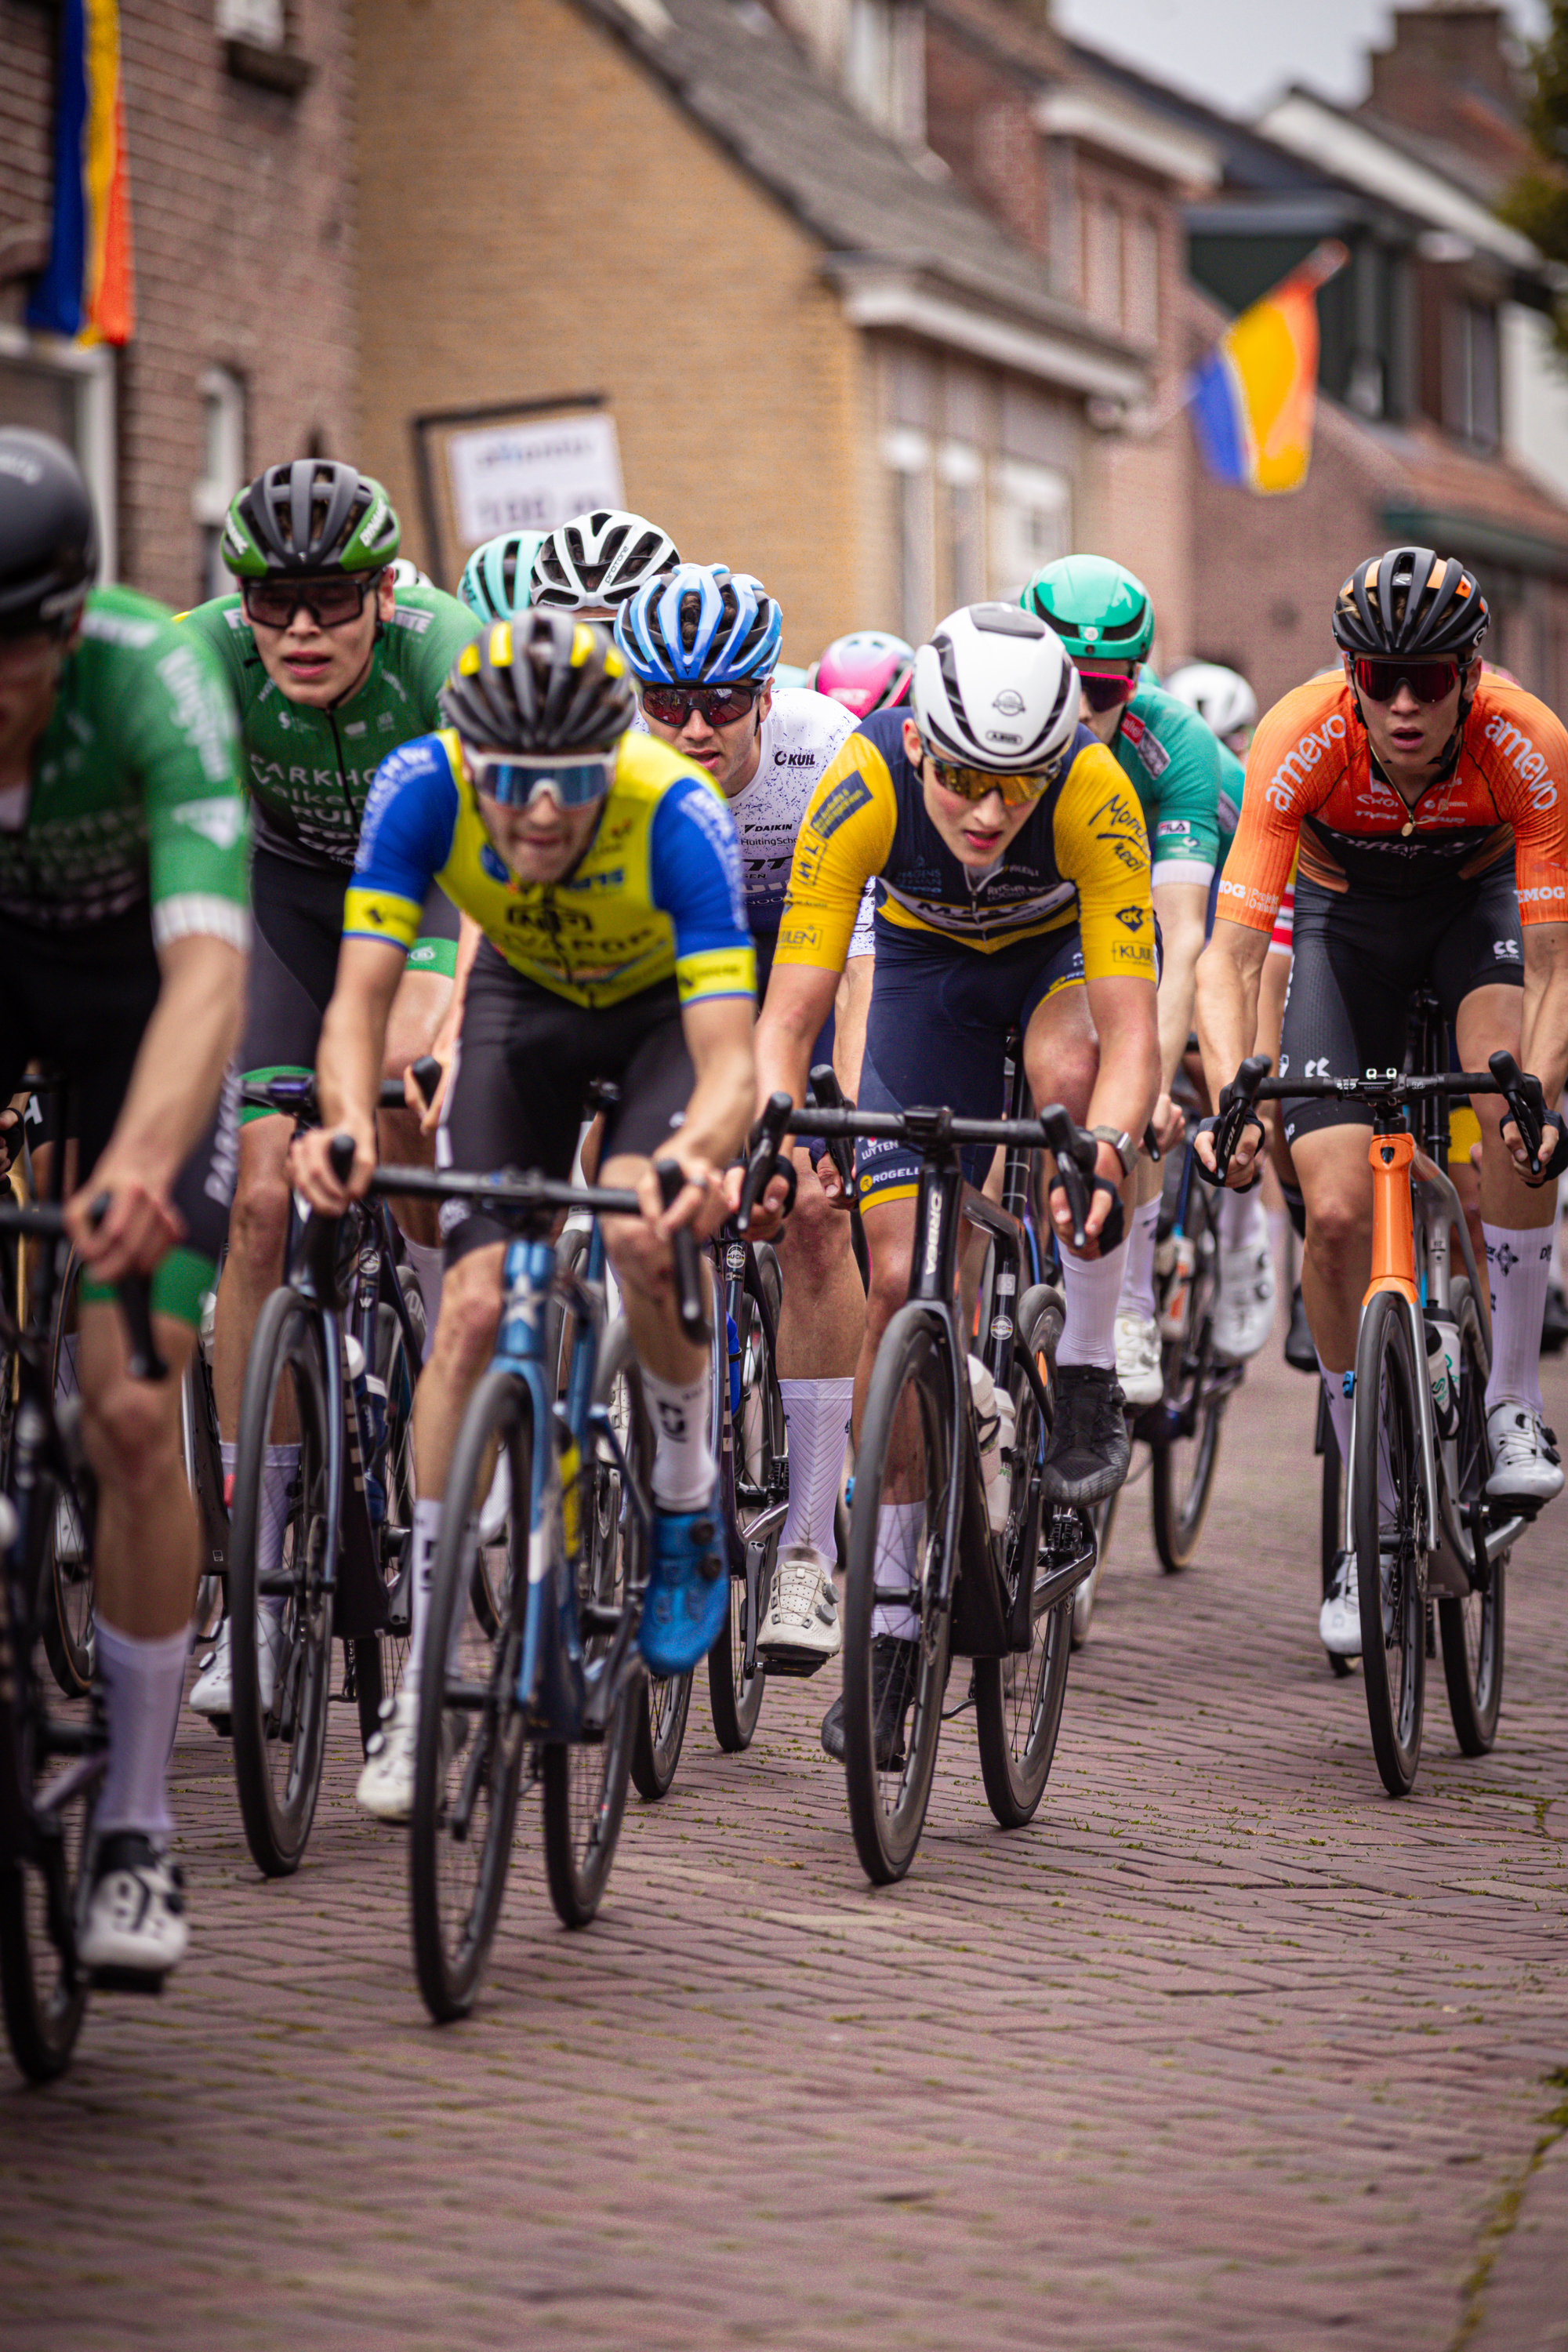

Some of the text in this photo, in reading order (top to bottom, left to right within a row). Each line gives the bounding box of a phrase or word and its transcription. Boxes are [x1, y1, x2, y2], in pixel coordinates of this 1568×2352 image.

[787, 753, 815, 766] KUIL
[1265, 714, 1346, 811] amevo
[1485, 714, 1558, 810] amevo
[754, 823, 793, 833] DAIKIN
[1160, 822, 1186, 832] FILA
[862, 1139, 899, 1160] LUYTEN
[925, 1192, 943, 1276] ORBEA
